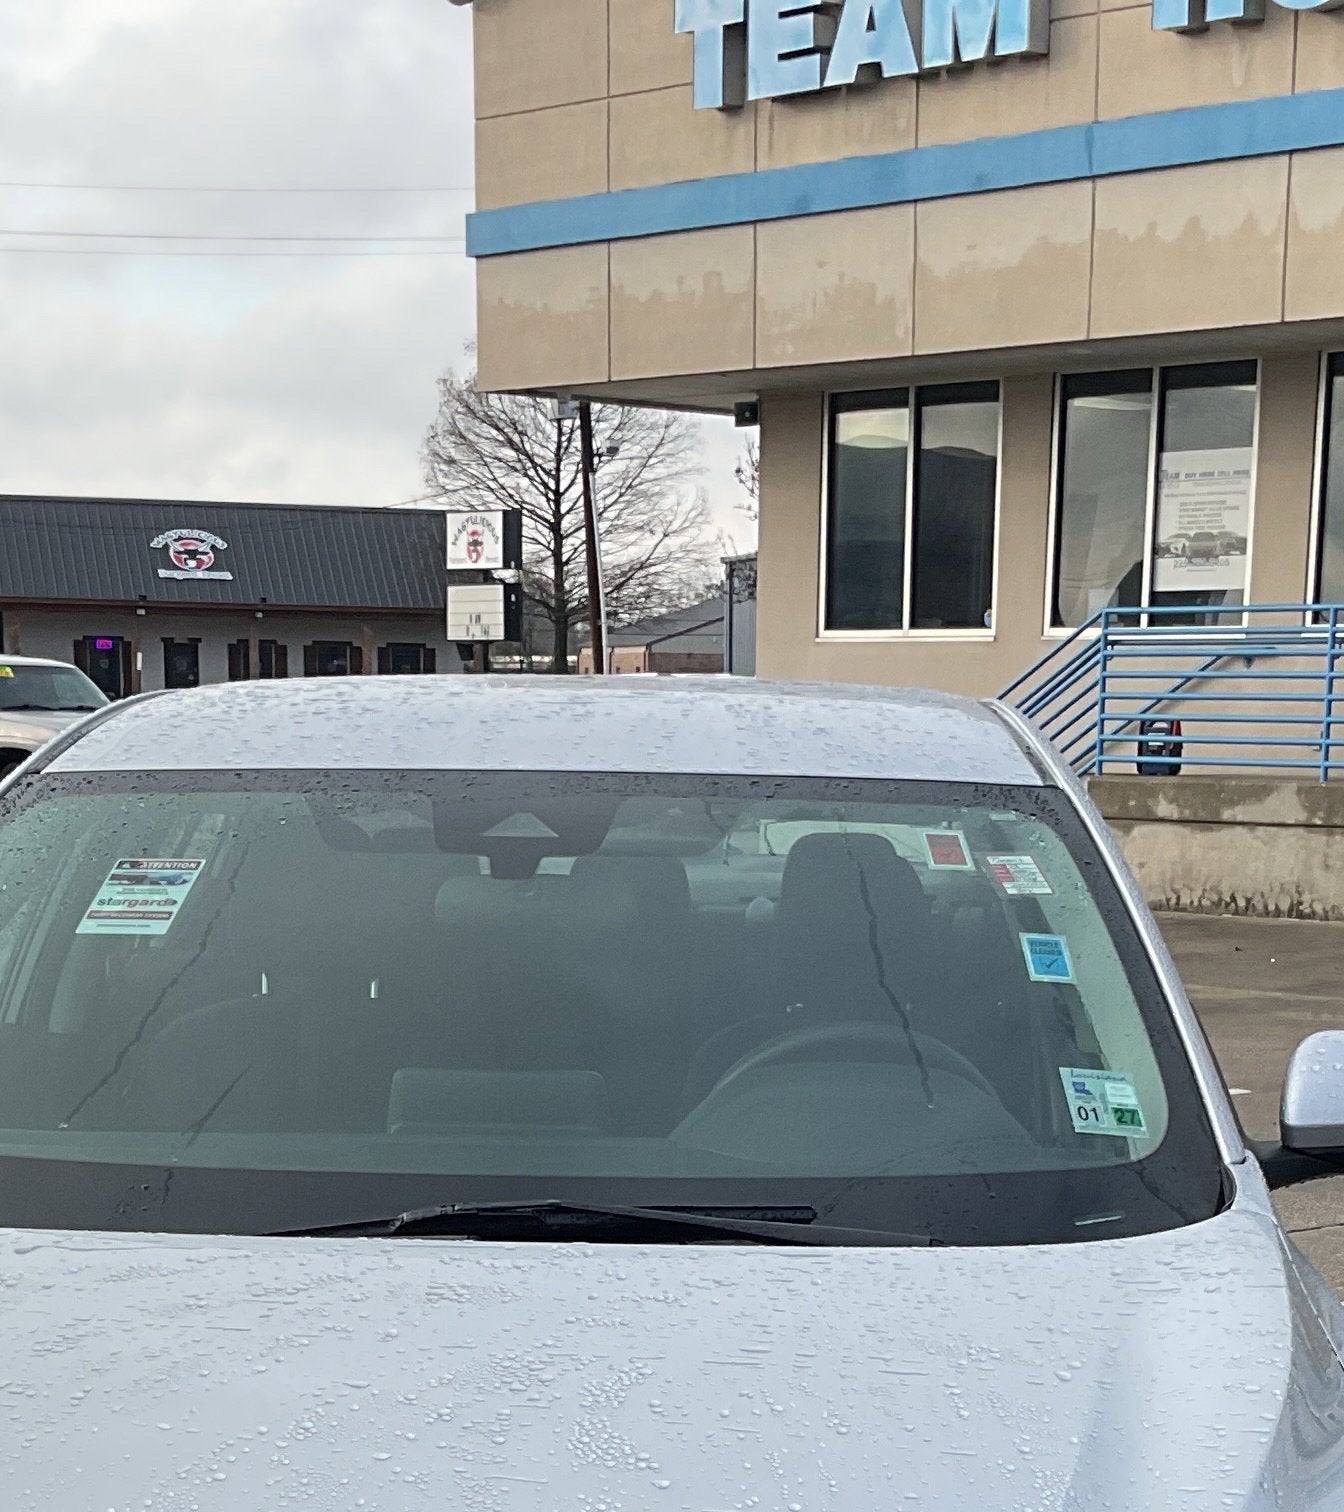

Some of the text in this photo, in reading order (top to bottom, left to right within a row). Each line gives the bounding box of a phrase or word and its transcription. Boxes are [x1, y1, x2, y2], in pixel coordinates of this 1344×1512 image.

[674, 0, 1030, 110] TEAM
[140, 861, 198, 869] ATTENTION
[1077, 1105, 1099, 1122] 01
[1113, 1108, 1137, 1125] 27
